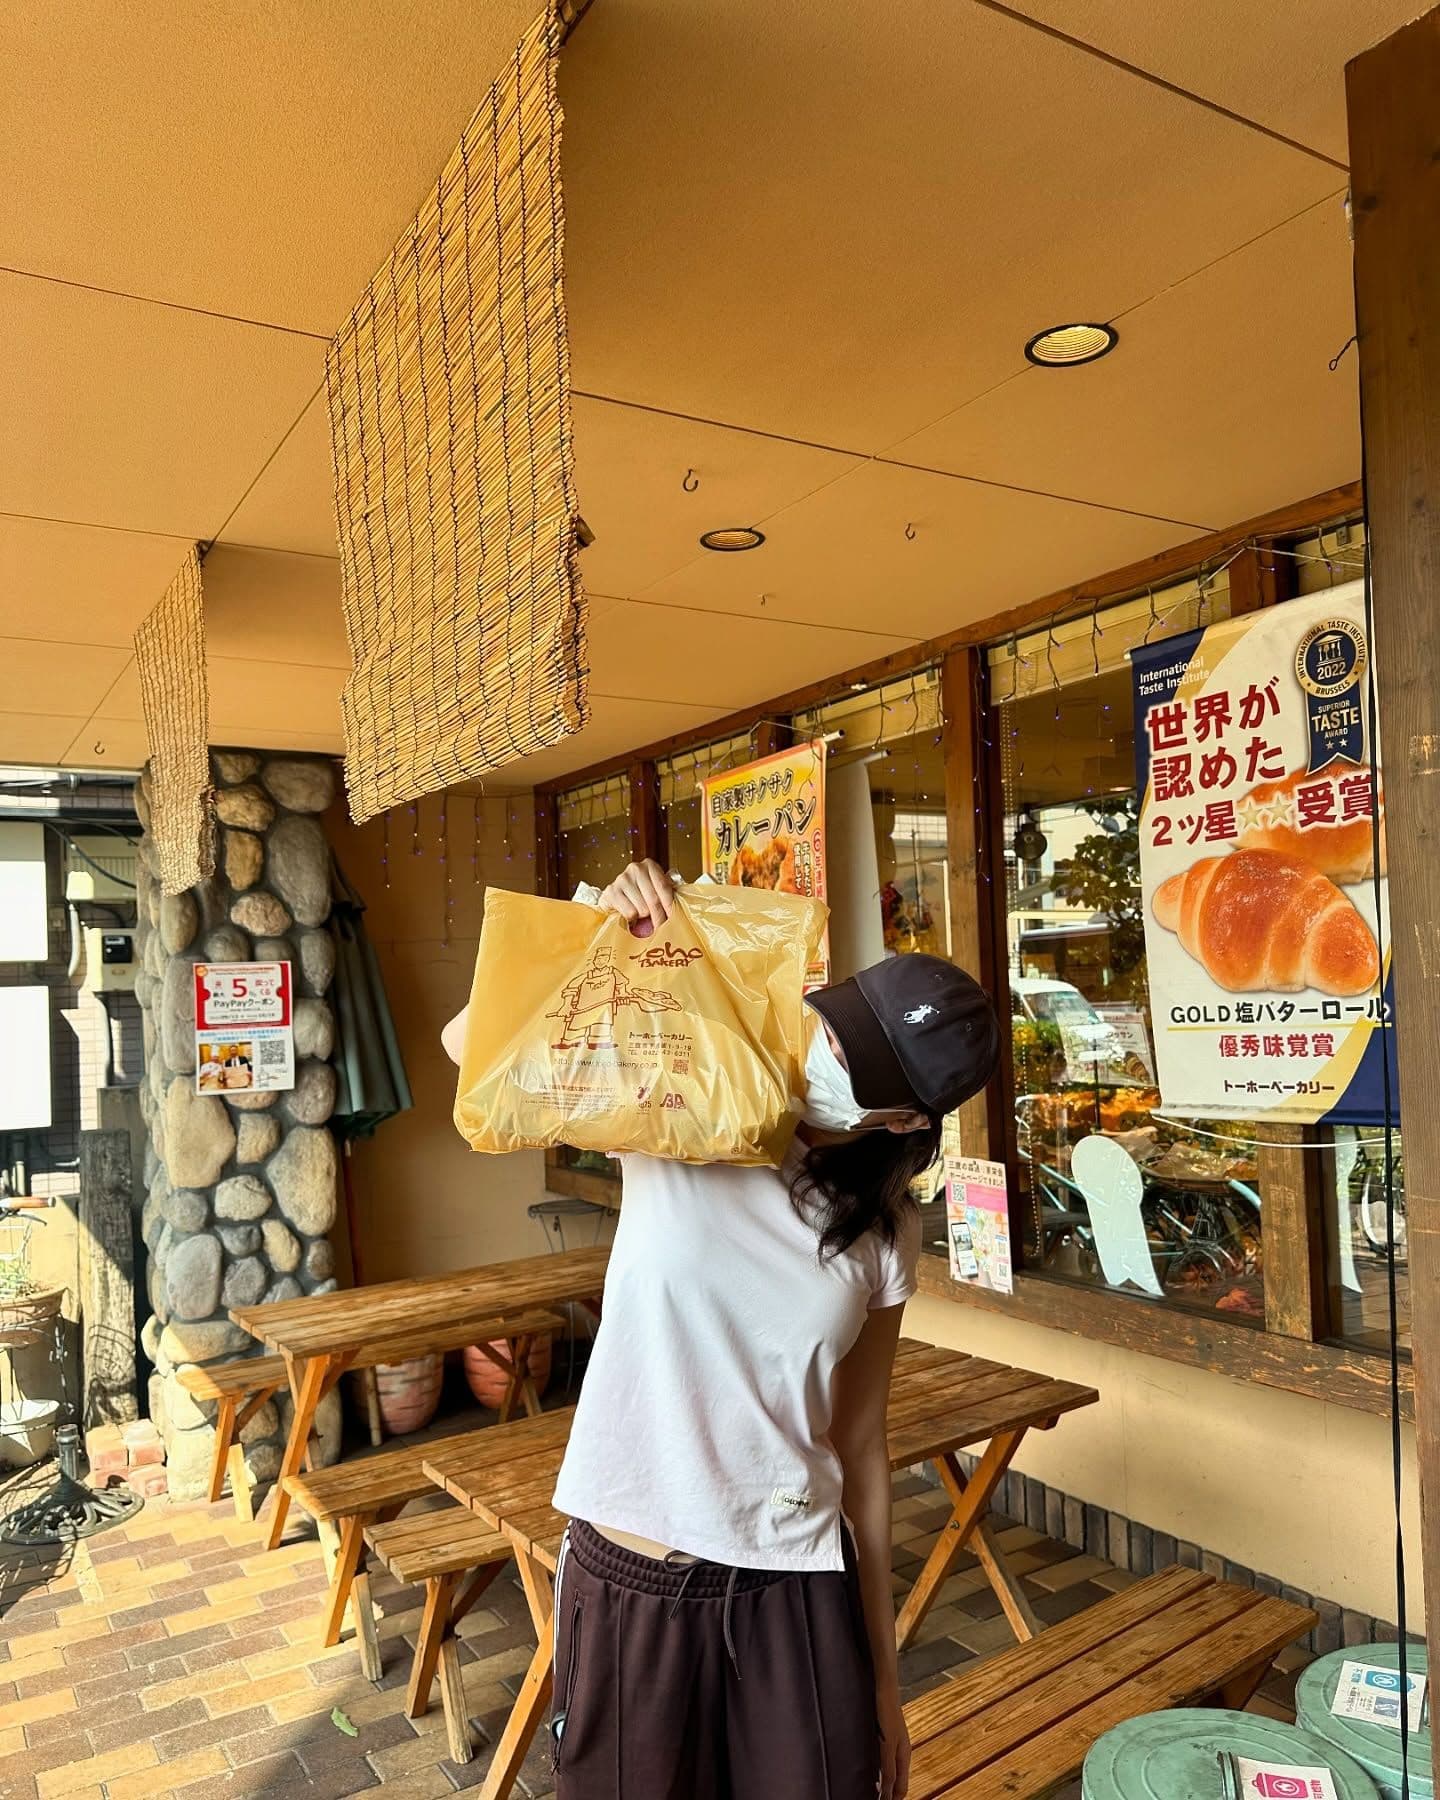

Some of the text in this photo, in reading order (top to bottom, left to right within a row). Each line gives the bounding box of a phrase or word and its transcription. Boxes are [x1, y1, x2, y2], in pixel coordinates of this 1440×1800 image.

[1298, 620, 1366, 679] INTERNATIONAL TASTE INSTITUTE
[1139, 656, 1204, 683] International
[1317, 662, 1346, 680] 2022
[1139, 670, 1209, 696] Taste Institute
[1315, 680, 1351, 696] BRUSSELS
[1147, 676, 1280, 751] 世界が
[1318, 699, 1350, 714] SUPERIOR
[1311, 707, 1360, 733] TASTE
[1324, 728, 1348, 739] AWARD
[1152, 737, 1285, 802] 認めた
[711, 768, 793, 818] 自家製サクサク
[1297, 774, 1374, 828] 受賞
[715, 797, 816, 858] カレーパン
[640, 957, 693, 968] BAKERY
[214, 998, 275, 1009] PayPayクーポン
[628, 1031, 693, 1040] トーホーベーカリー
[1219, 1033, 1335, 1058] 優秀味覚賞
[1223, 1080, 1335, 1095] トーホーベーカリー
